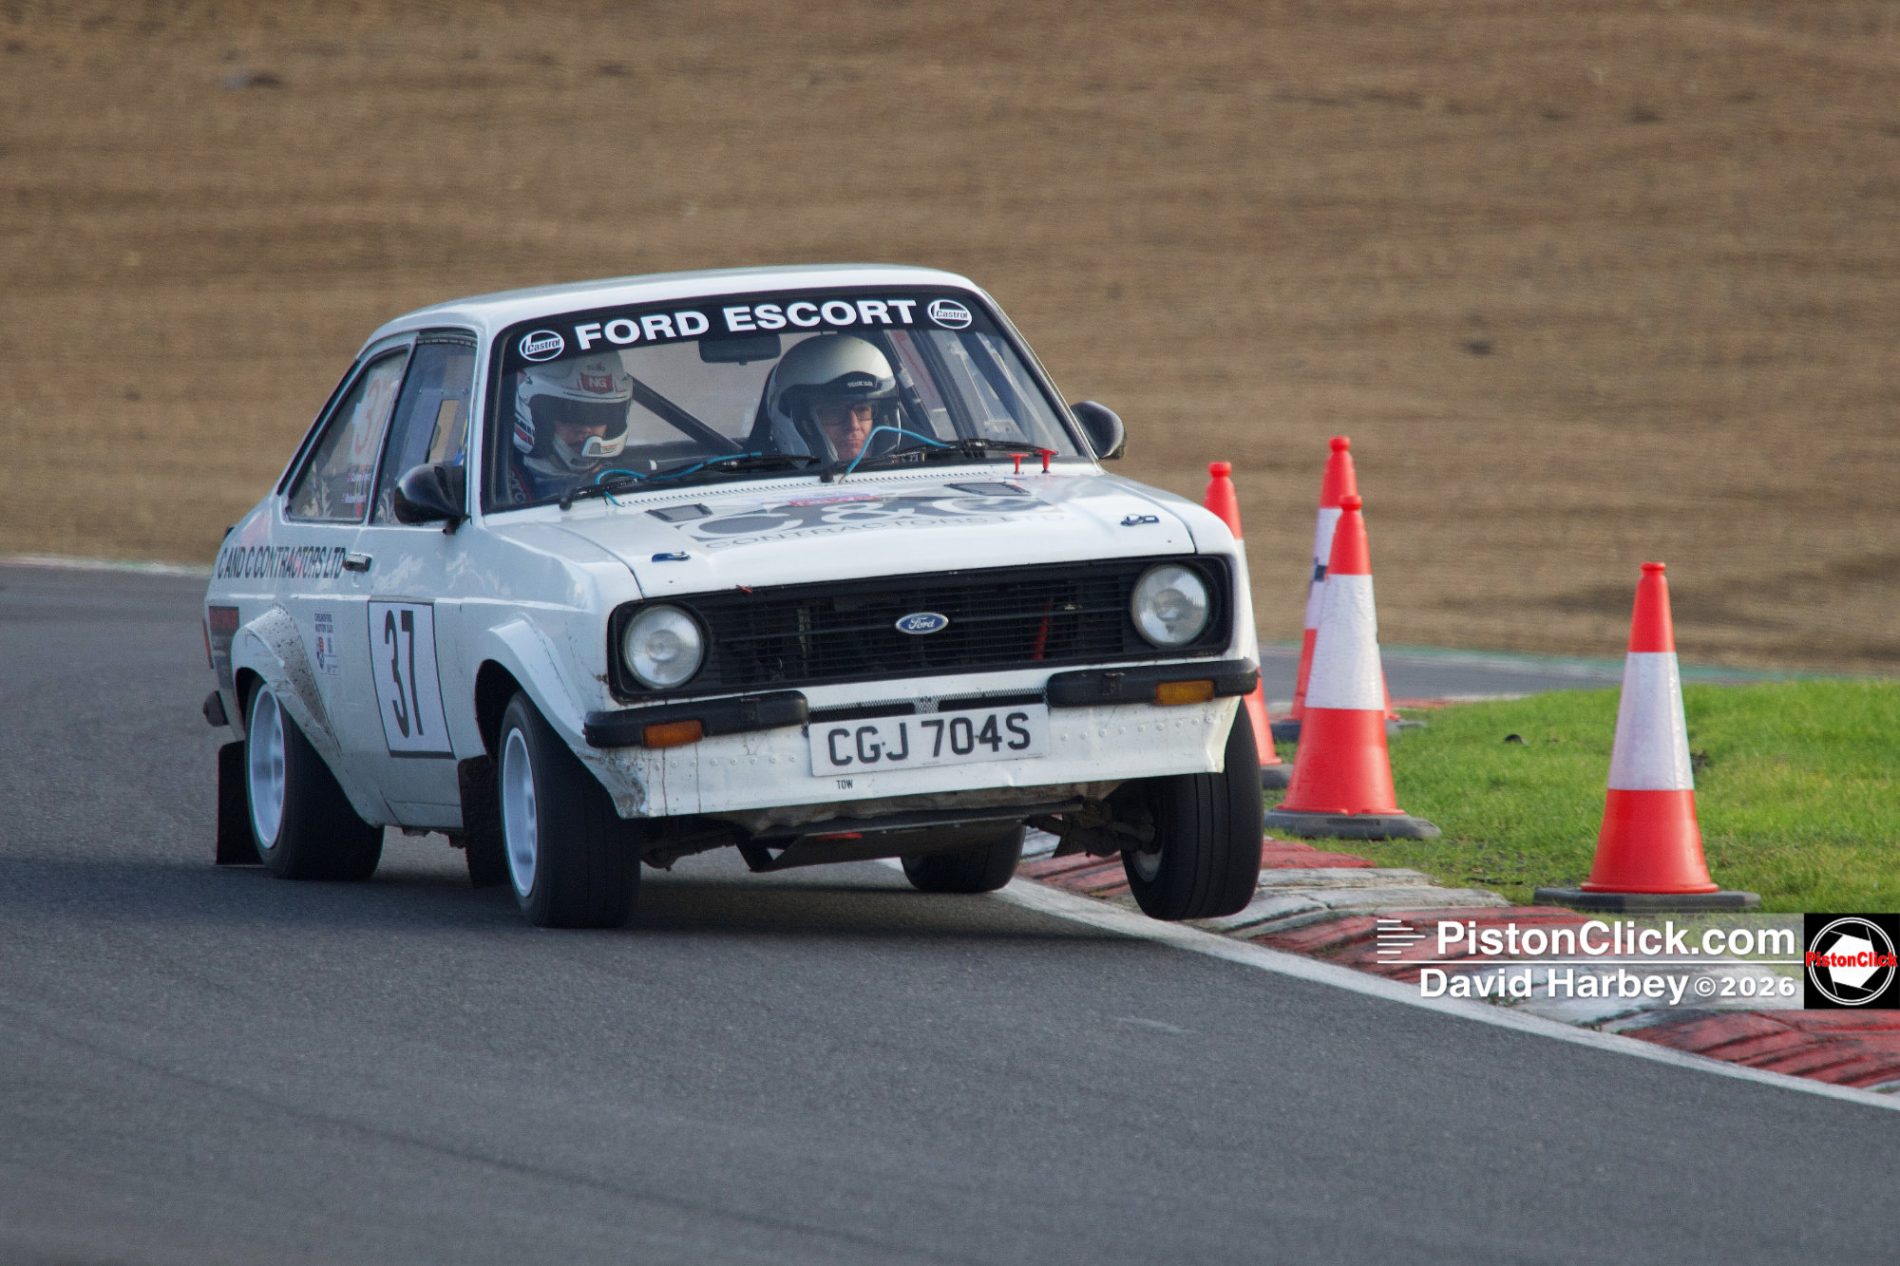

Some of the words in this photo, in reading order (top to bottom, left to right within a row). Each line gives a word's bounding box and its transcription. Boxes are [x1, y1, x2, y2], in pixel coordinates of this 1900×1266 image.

[573, 311, 710, 350] FORD
[722, 299, 917, 332] ESCORT
[934, 307, 969, 322] Castrol
[526, 338, 562, 355] Castrol
[705, 517, 989, 548] CONTRACTORS
[225, 546, 246, 579] AND
[254, 545, 327, 579] CONTRACTORS
[323, 547, 347, 579] LTD
[908, 617, 936, 630] Ford
[385, 609, 424, 739] 37
[828, 722, 910, 767] CGJ
[921, 712, 1031, 758] 704S
[836, 779, 854, 790] TOW
